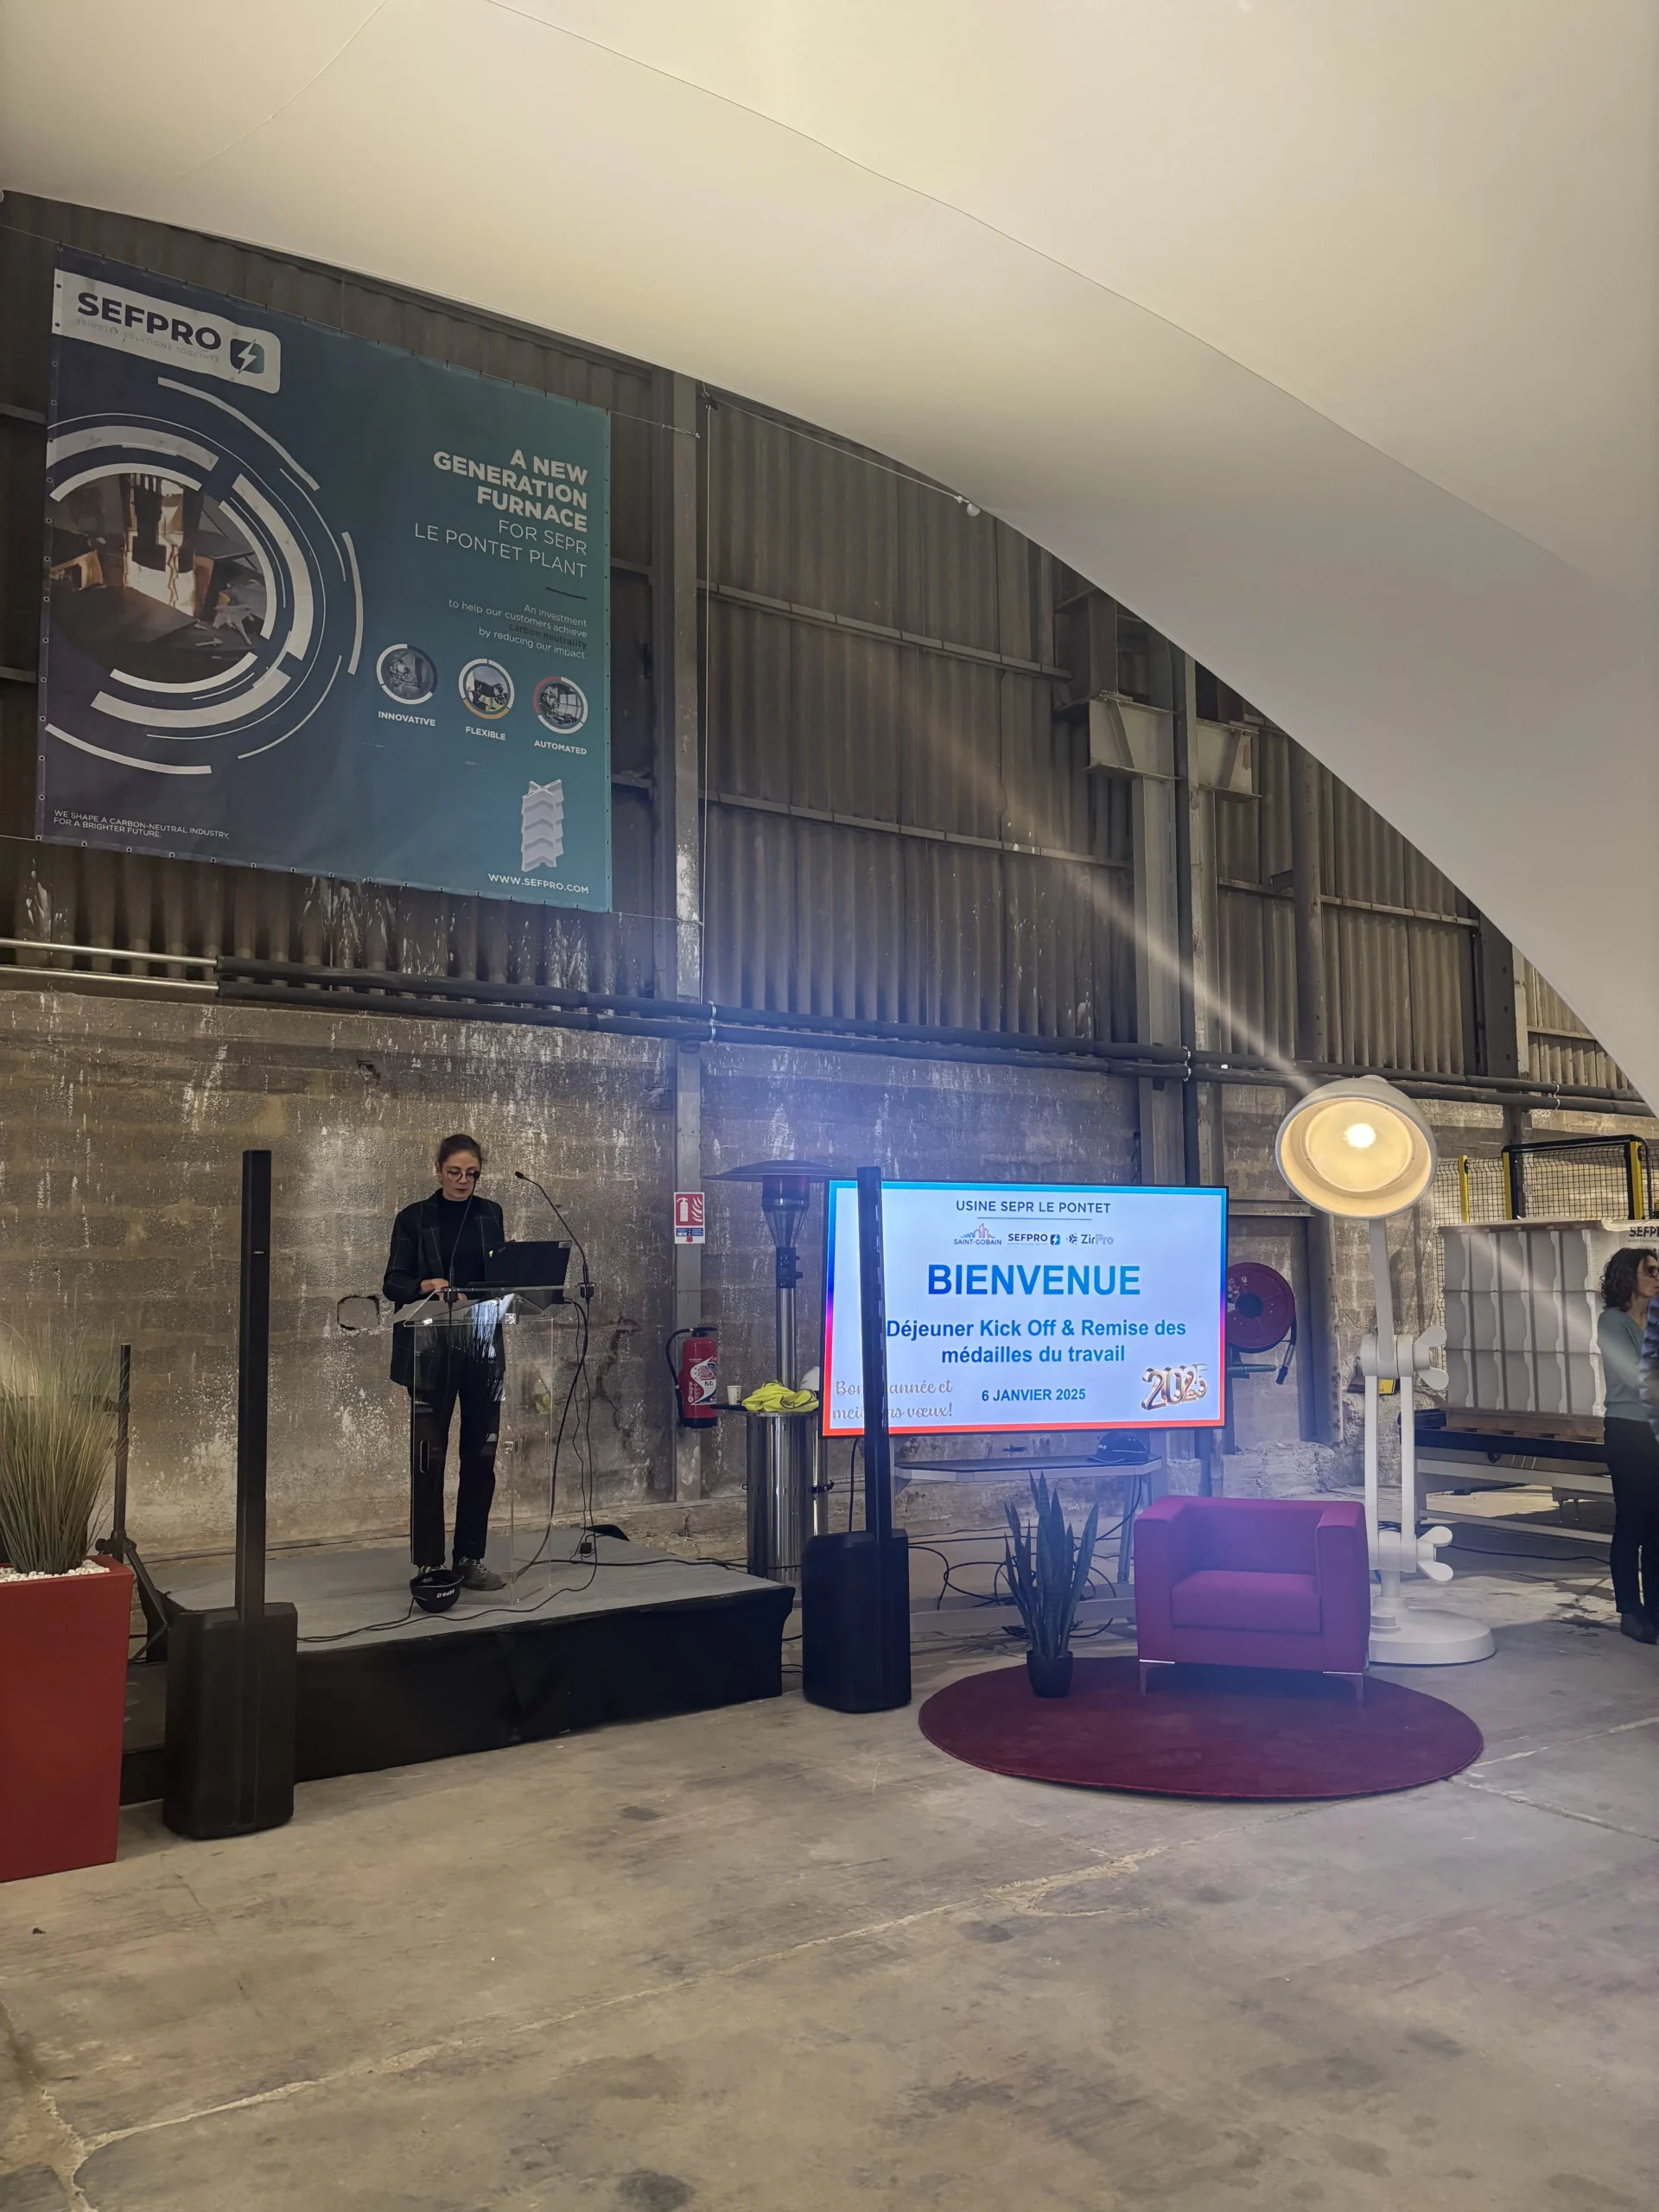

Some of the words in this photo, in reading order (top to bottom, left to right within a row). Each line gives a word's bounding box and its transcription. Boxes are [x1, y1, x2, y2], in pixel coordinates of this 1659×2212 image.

[77, 292, 222, 350] SEFPRO
[510, 449, 526, 470] A
[533, 455, 588, 486] NEW
[433, 451, 588, 510] GENERATION
[477, 486, 588, 533] FURNACE
[499, 519, 537, 542] FOR
[543, 530, 587, 556] SEPR
[415, 523, 438, 542] LE
[446, 530, 523, 561] PONTET
[530, 550, 588, 578] PLANT
[449, 599, 459, 608] to
[461, 601, 483, 614] help
[486, 608, 503, 617] our
[505, 612, 551, 630] customers
[553, 625, 588, 638] achieve
[524, 605, 537, 614] An
[539, 608, 588, 627] investment
[479, 626, 491, 638] by
[493, 632, 534, 649] reducing
[537, 642, 552, 652] our
[554, 645, 588, 659] impact.
[509, 624, 541, 638] carbon
[543, 632, 588, 650] neutrality
[378, 710, 436, 727] INNOVATIVE
[465, 726, 506, 741] FLEXIBLE
[534, 740, 588, 755] AUTOMATED
[54, 810, 69, 818] WE
[71, 812, 99, 823] SHAPE
[110, 817, 188, 834] CARBON-NEUTRAL
[189, 827, 230, 840] INDUSTRY,
[54, 817, 72, 826] FOR
[82, 822, 125, 833] BRIGHTER
[127, 827, 162, 838] FUTURE.
[487, 874, 589, 894] WWW.SEFPRO.COM
[956, 1200, 996, 1211] USINE
[1001, 1201, 1034, 1212] SEPR
[1039, 1202, 1054, 1212] LE
[1059, 1202, 1111, 1213] PONTET
[1007, 1233, 1048, 1242] SEFPRO
[1081, 1234, 1114, 1245] ZirPro
[928, 1264, 1141, 1295] BIENVENUE
[887, 1319, 974, 1341] Déjeuner
[981, 1319, 1021, 1337] Kick
[1027, 1319, 1057, 1337] Off
[1061, 1319, 1075, 1336] &
[1081, 1319, 1148, 1336] Remise
[1154, 1319, 1186, 1336] des
[941, 1345, 1033, 1363] médailles
[1039, 1345, 1062, 1362] du
[1068, 1345, 1125, 1362] travail
[889, 1379, 937, 1394] année
[938, 1378, 953, 1394] et
[982, 1390, 989, 1402] 6
[992, 1389, 1052, 1402] JANVIER
[1056, 1389, 1086, 1401] 2025
[1141, 1363, 1209, 1411] 2025
